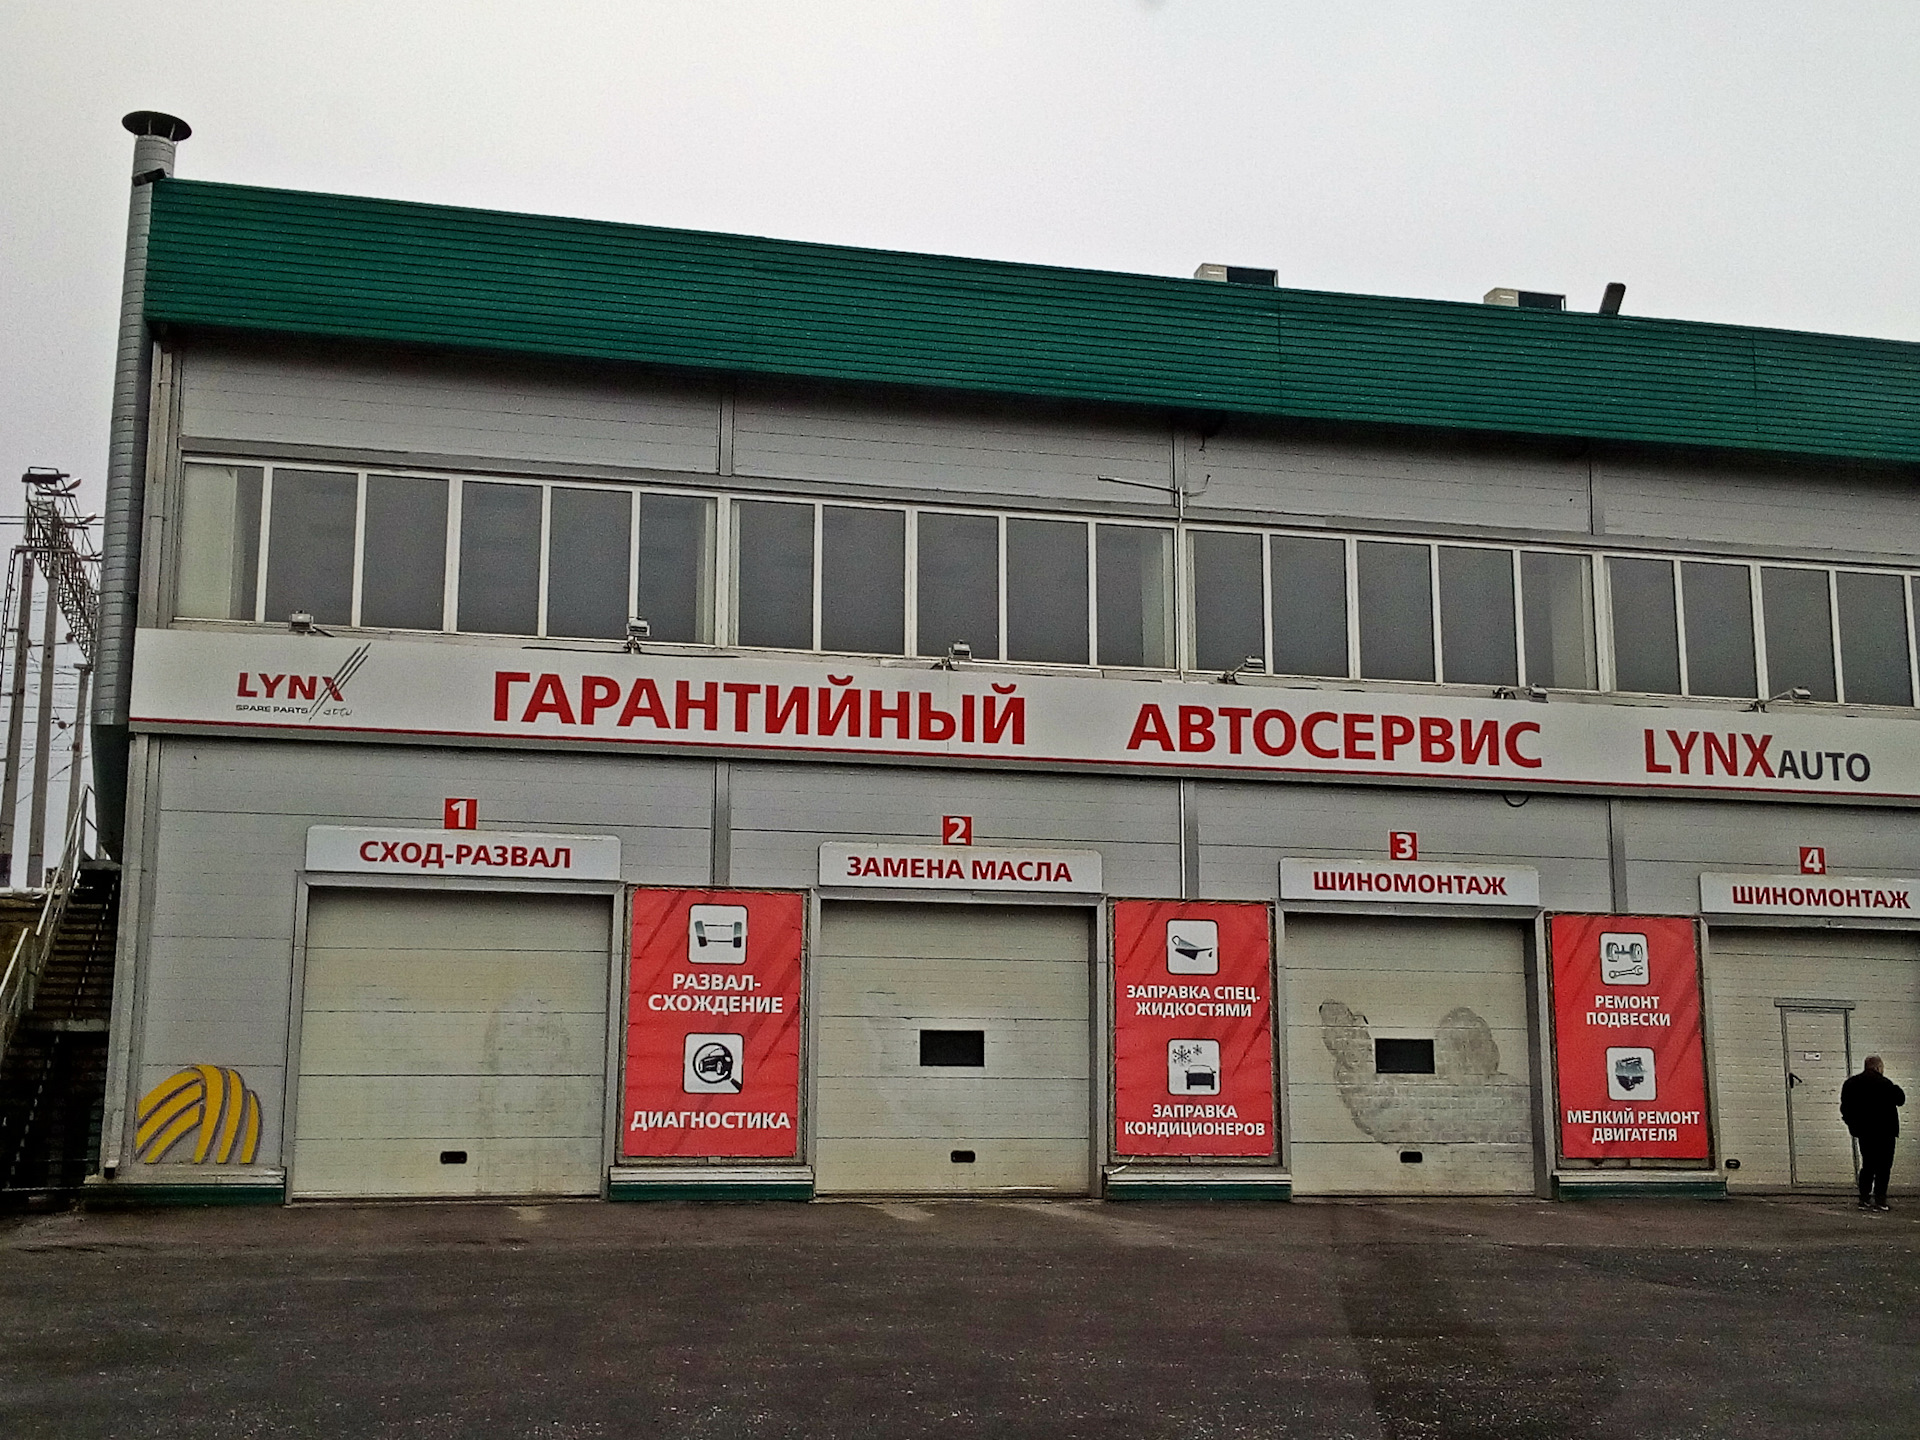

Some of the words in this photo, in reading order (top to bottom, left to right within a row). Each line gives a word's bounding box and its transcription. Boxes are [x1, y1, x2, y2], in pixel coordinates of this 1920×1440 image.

[237, 671, 346, 702] LYNX
[235, 704, 271, 713] SPARE
[273, 705, 309, 714] PARTS
[493, 670, 1025, 745] ГАРАНТИЙНЫЙ
[1126, 703, 1543, 769] АВТОСЕРВИС
[450, 799, 468, 829] 1
[947, 817, 967, 845] 2
[359, 840, 571, 869] СХОД-РАЗВАЛ
[1395, 833, 1414, 860] 3
[846, 855, 965, 880] ЗАМЕНА
[971, 859, 1073, 882] МАСЛА
[1803, 848, 1823, 873] 4
[1313, 871, 1508, 896] ШИНОМОНТАЖ
[1731, 885, 1911, 910] ШИНОМОНТАЖ
[672, 973, 761, 992] РАЗВАЛ-
[1126, 984, 1210, 1000] ЗАПРАВКА
[1213, 985, 1261, 1003] СПЕЦ.
[1595, 994, 1660, 1010] РЕМОНТ
[648, 994, 784, 1015] СХОЖДЕНИЕ
[1135, 1002, 1252, 1018] ЖИДКОСТЯМИ
[1586, 1011, 1671, 1028] ПОДВЕСКИ
[630, 1110, 791, 1132] ДИАГНОСТИКА
[1152, 1103, 1238, 1119] ЗАПРАВКА
[1567, 1107, 1635, 1125] МЕЛКИЙ
[1638, 1110, 1700, 1126] РЕМОНТ
[1124, 1121, 1266, 1138] КОНДИЦИОНЕРОВ
[1591, 1127, 1678, 1144] ДВИГАТЕЛЯ
